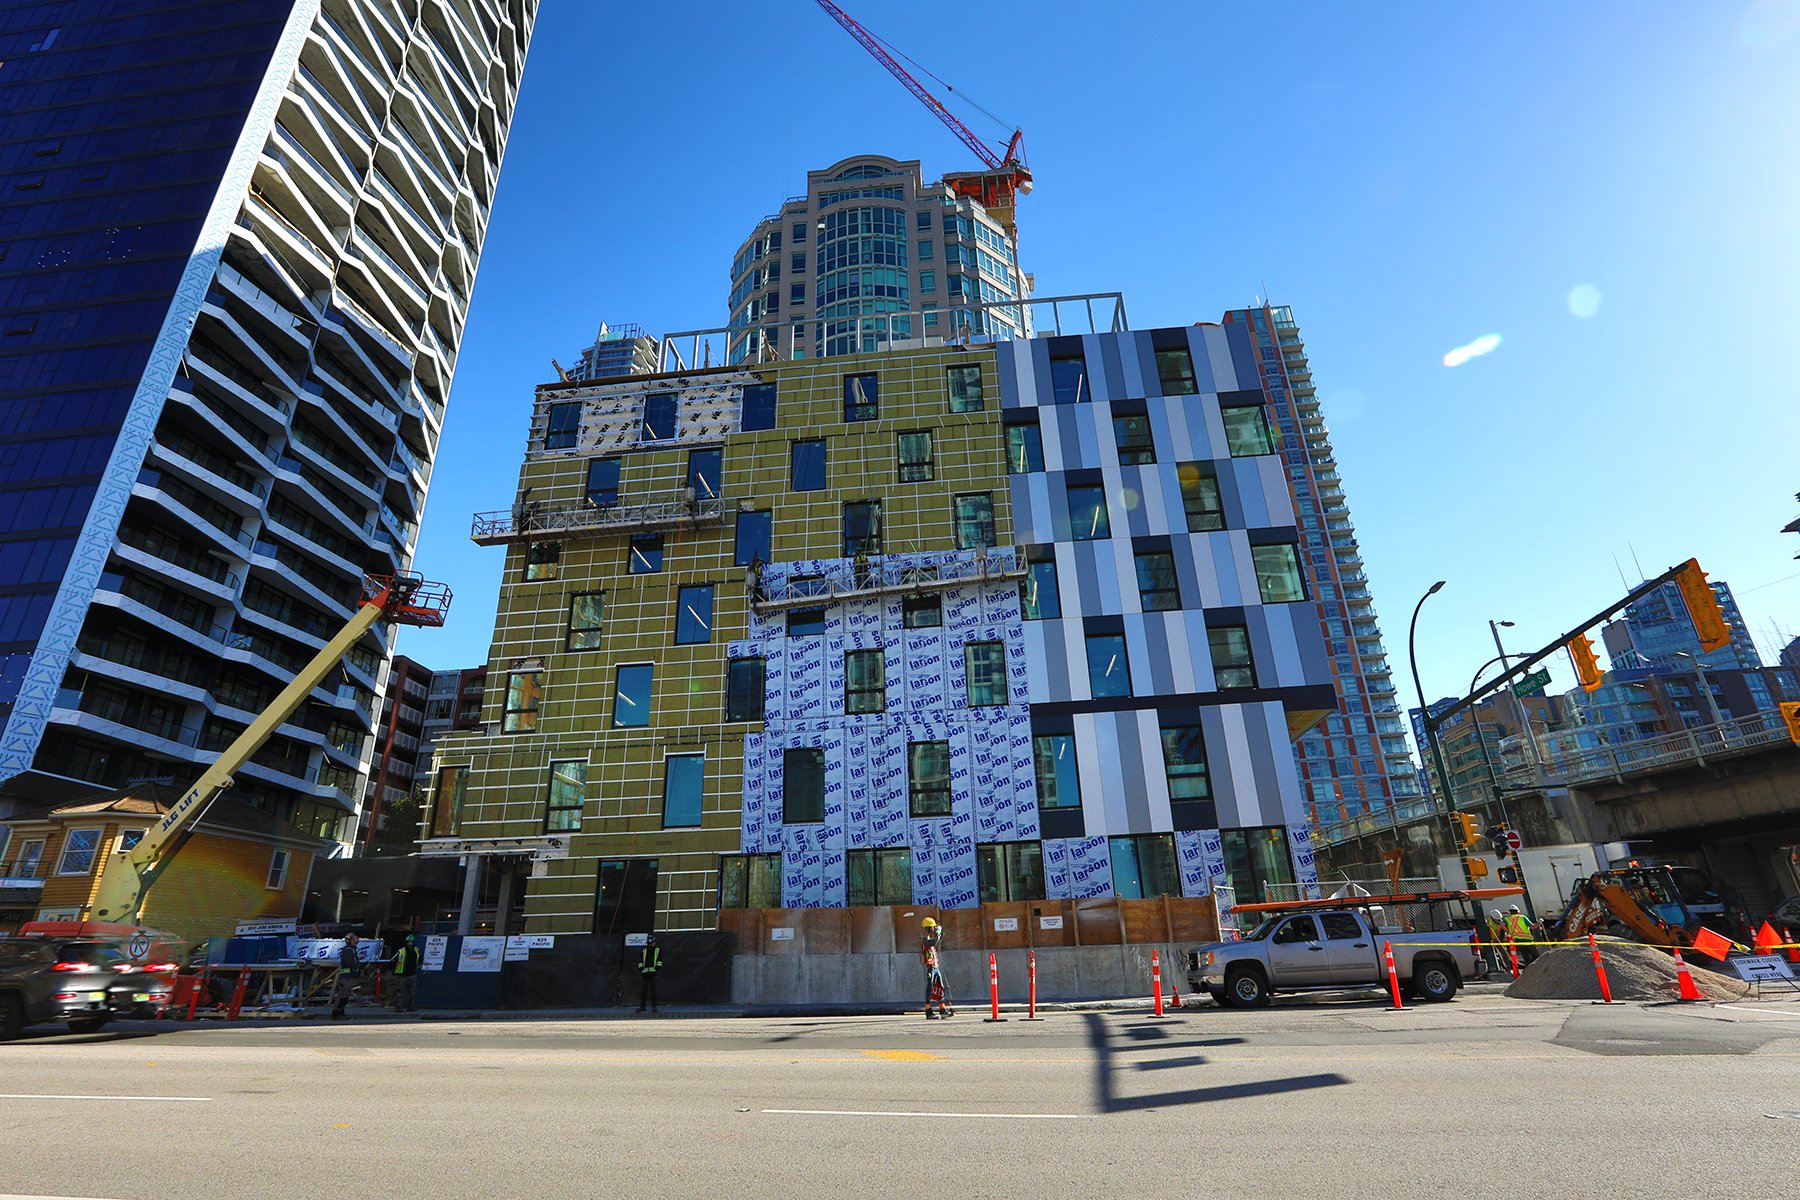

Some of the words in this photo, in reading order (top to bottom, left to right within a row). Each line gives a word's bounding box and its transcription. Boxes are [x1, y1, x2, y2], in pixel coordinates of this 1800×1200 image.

[986, 590, 1017, 603] larson
[987, 608, 1018, 622] larson
[1516, 680, 1536, 696] Howe
[1537, 672, 1548, 684] St
[162, 811, 178, 832] JLG
[179, 789, 198, 812] LIFT
[938, 845, 972, 862] larson
[1070, 836, 1105, 859] larson
[940, 867, 973, 885] larson
[1073, 858, 1108, 881] larson
[941, 890, 975, 909] larson
[1569, 904, 1586, 932] CASE
